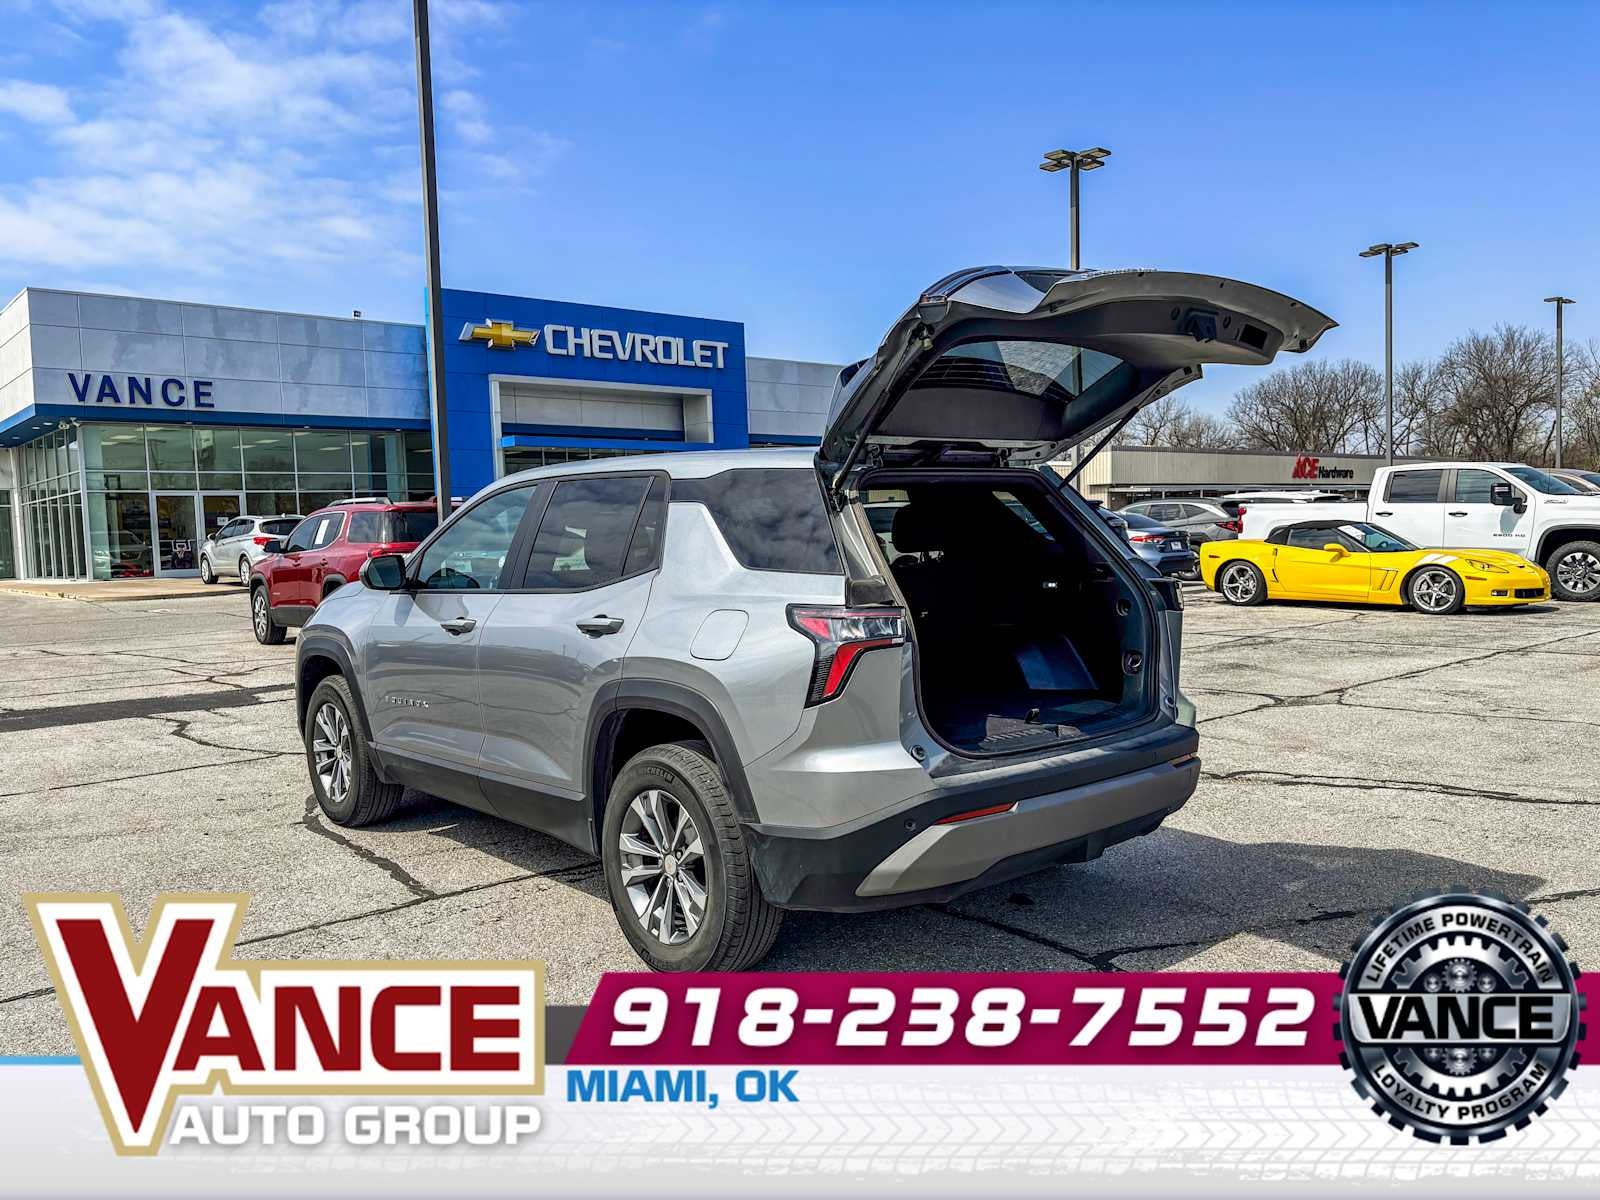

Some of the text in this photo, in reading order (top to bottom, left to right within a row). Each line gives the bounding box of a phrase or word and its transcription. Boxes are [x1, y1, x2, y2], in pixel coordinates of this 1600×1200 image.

[543, 324, 729, 369] CHEVROLET
[68, 373, 215, 408] VANCE
[1292, 455, 1354, 478] ACE Hardware
